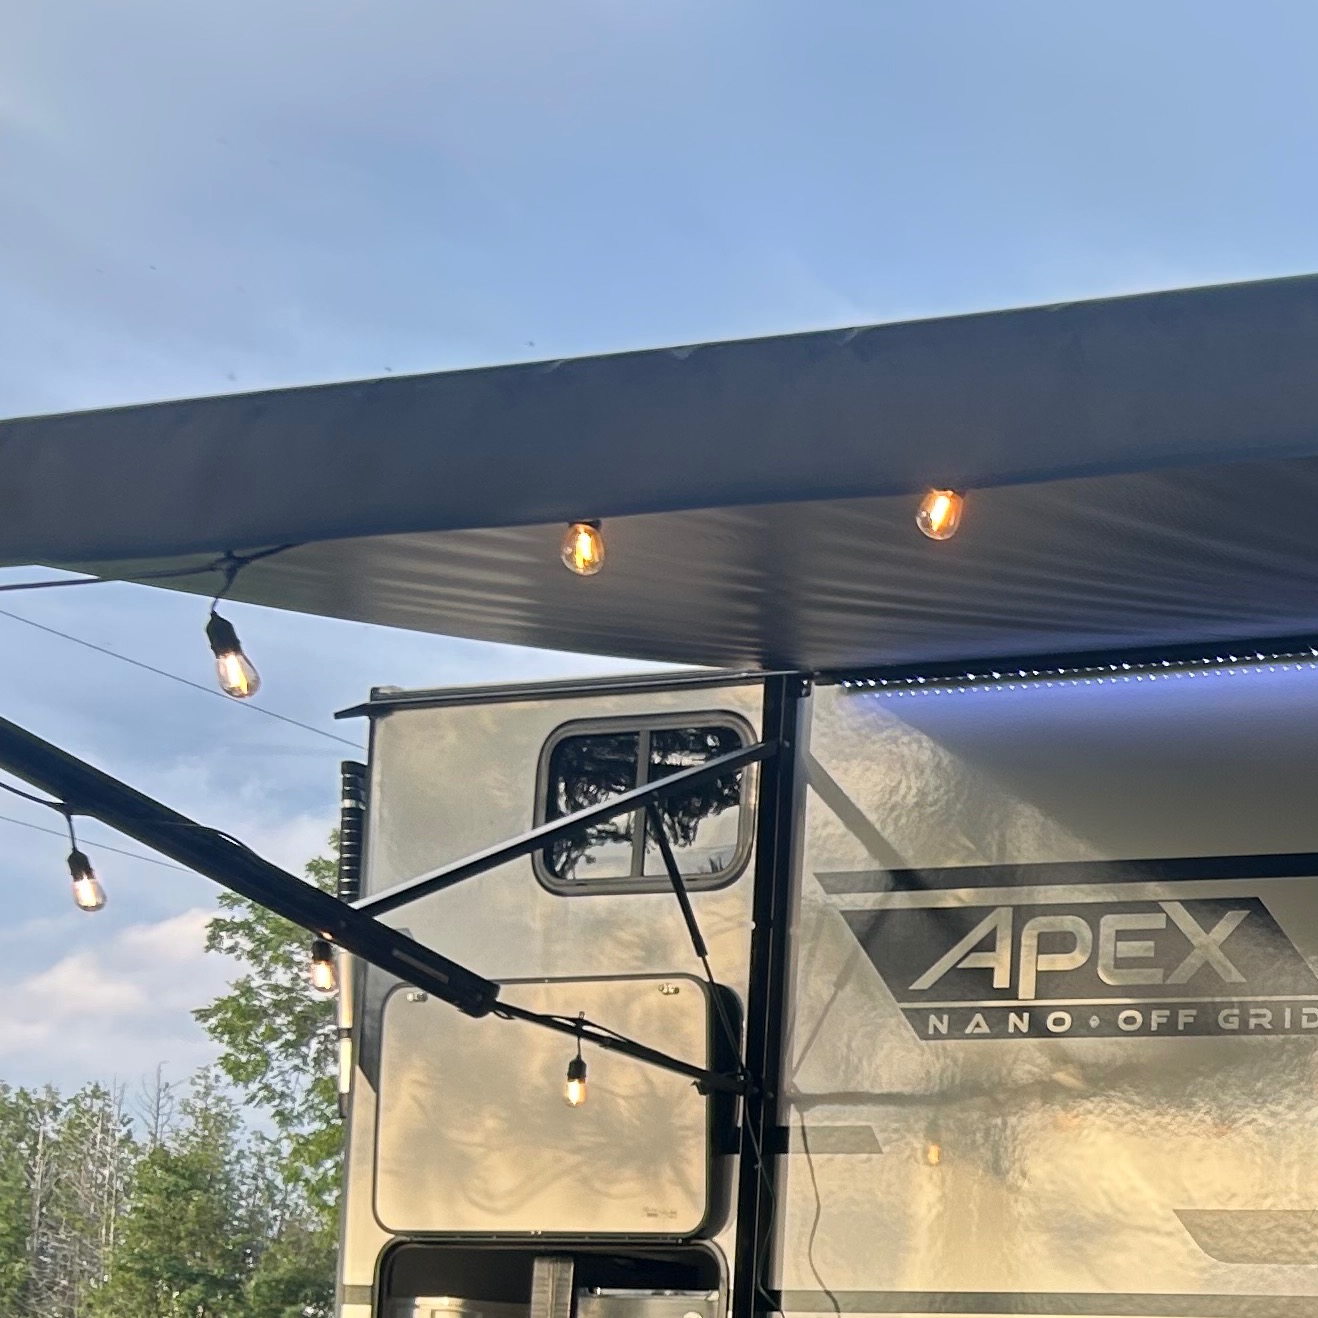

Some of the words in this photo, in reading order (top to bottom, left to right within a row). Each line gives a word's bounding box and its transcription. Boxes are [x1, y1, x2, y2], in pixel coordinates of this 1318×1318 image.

[908, 900, 1252, 1000] APEX
[927, 1009, 1073, 1034] NANO
[1117, 1008, 1199, 1032] OFF
